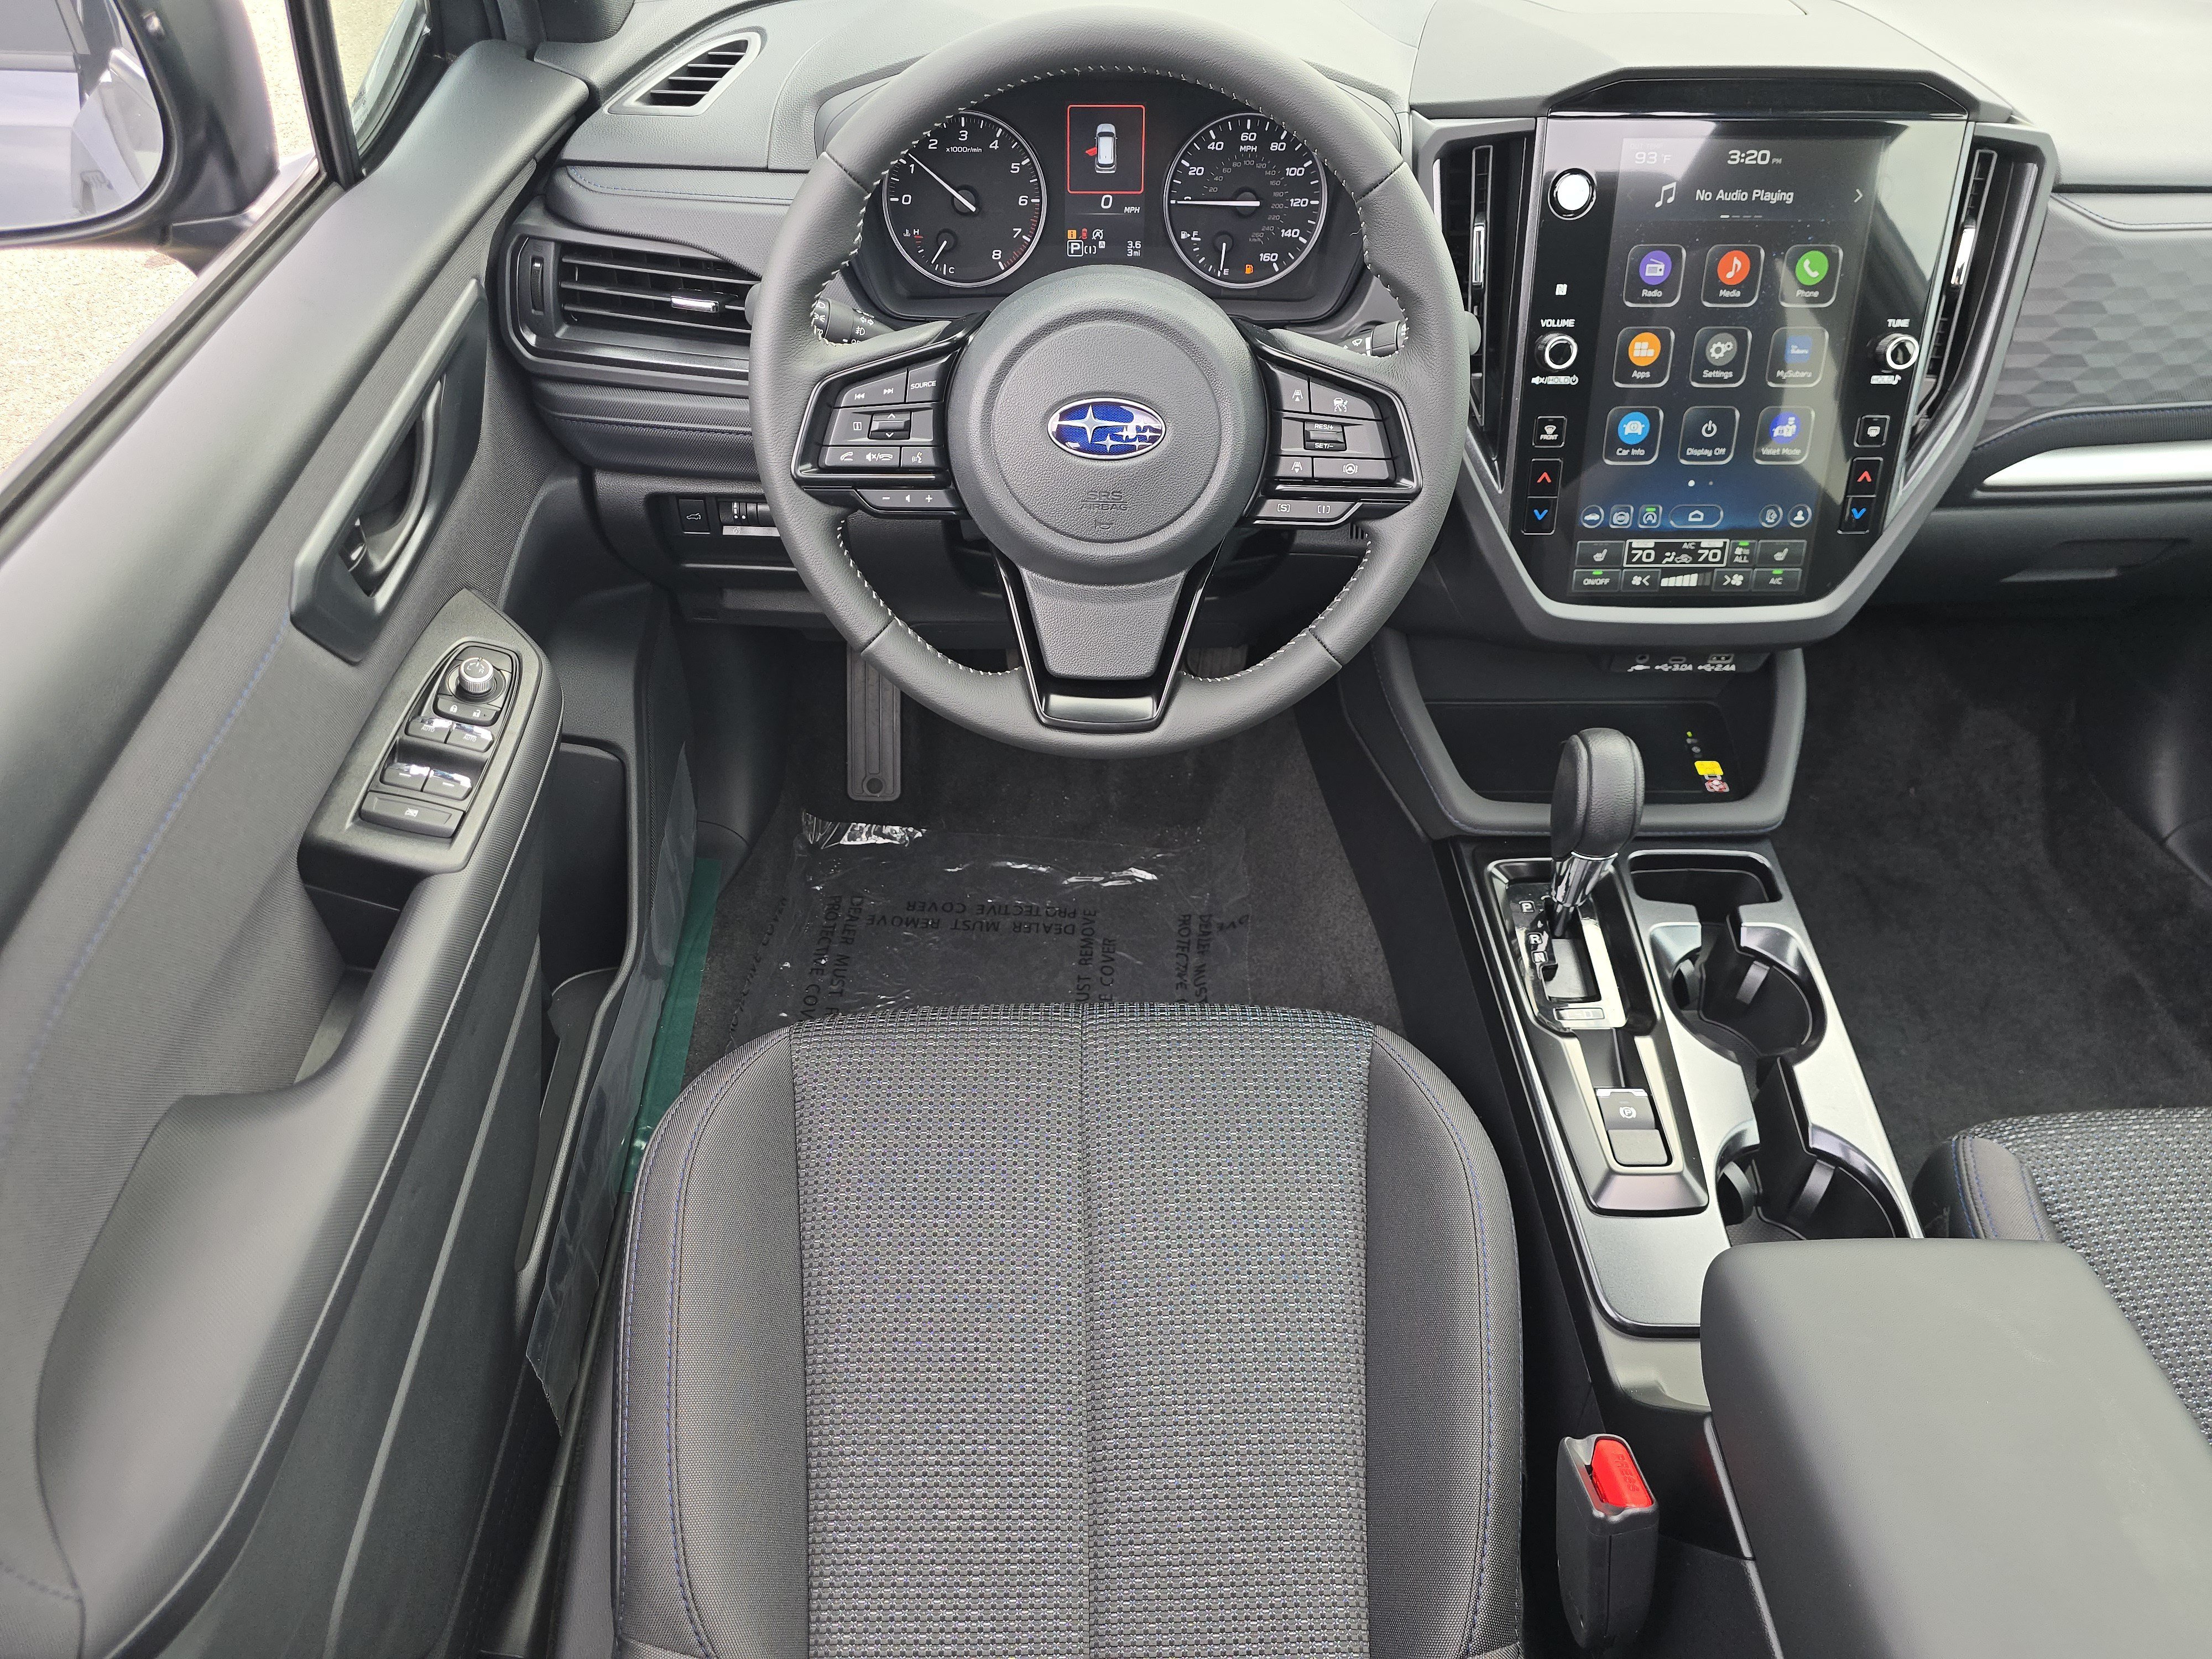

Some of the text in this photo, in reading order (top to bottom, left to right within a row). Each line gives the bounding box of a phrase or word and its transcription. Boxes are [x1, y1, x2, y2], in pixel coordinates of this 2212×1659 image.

[959, 130, 968, 141] 3
[1240, 132, 1257, 142] 60
[928, 139, 938, 149] 2
[989, 140, 999, 150] 4
[1207, 142, 1224, 150] 40
[1270, 142, 1286, 151] 80
[1635, 152, 1657, 164] 93
[1727, 149, 1770, 165] 3:20
[910, 164, 915, 174] 1
[1010, 163, 1020, 173] 5
[1188, 167, 1204, 176] 20
[1285, 167, 1305, 176] 100
[901, 194, 912, 205] 0
[1018, 195, 1029, 206] 6
[1101, 194, 1113, 209] 0
[1695, 189, 1794, 204] No Audio Playing
[1290, 198, 1309, 207] 120
[1013, 228, 1022, 238] 7
[1280, 228, 1300, 238] 140
[1127, 241, 1141, 249] 3.6
[992, 249, 1002, 260] 8
[1259, 253, 1279, 262] 160
[1641, 289, 1662, 298] Radio
[1719, 289, 1741, 298] Media
[1796, 289, 1819, 298] Phone
[1540, 319, 1575, 328] VOLUME
[1886, 319, 1911, 328] TUNE
[1632, 370, 1651, 379] Apps
[1703, 370, 1734, 379] Settings
[910, 380, 937, 389] SOURCE
[1616, 447, 1645, 456] Car Info
[1686, 447, 1726, 457] Display Off
[1761, 447, 1802, 456] Valet Mode
[1086, 491, 1123, 500] SRS
[1081, 503, 1129, 512] AIRBAG
[1631, 549, 1655, 562] 70
[1697, 549, 1721, 562] 70
[906, 900, 1077, 919] PROTECTIVE COVER
[1521, 902, 1532, 912] P
[842, 895, 864, 946] DEALER
[867, 914, 1075, 936] DEALER MUST REMOVE
[809, 895, 842, 976] PROTECTIVE
[1529, 935, 1540, 945] R
[1076, 909, 1097, 1003] UST REMOVE
[1099, 937, 1116, 987] COVER
[829, 953, 851, 996] MUST
[800, 984, 821, 1020] COV
